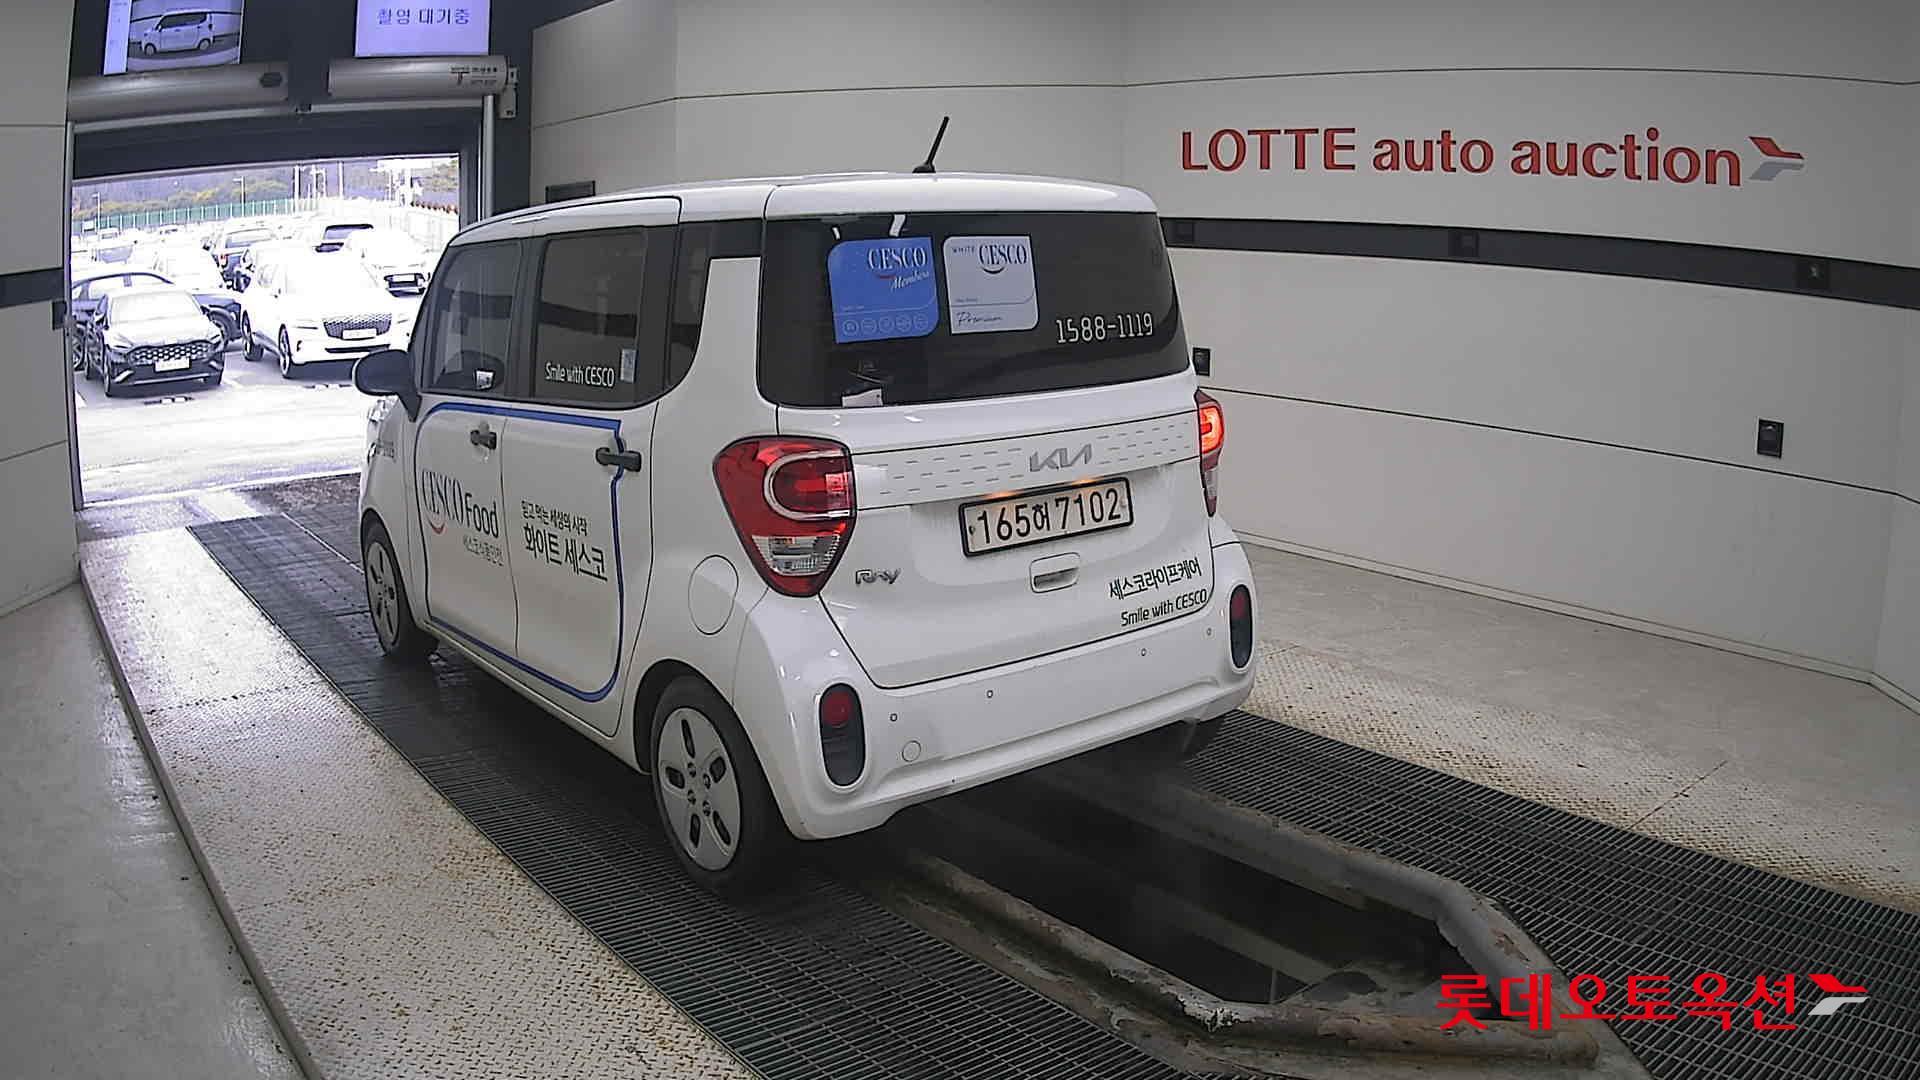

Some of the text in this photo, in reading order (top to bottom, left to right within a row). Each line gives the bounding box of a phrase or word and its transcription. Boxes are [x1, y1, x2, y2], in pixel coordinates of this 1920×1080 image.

[418, 8, 470, 25] 대기중
[1182, 126, 1742, 187] LOTTE auto auction
[867, 247, 927, 270] CESCO
[978, 244, 1028, 265] CESCO
[1056, 312, 1153, 344] 1588-1119
[545, 361, 615, 387] Smile with CESCO
[422, 468, 499, 539] CESCO Food
[978, 487, 1121, 544] 165허 7102
[550, 508, 571, 532] 세상의
[572, 512, 588, 537] 시작
[523, 522, 608, 582] 화이트 세스코
[1108, 557, 1202, 600] 세스코라이프케어
[1120, 588, 1208, 627] Smile with CESCO
